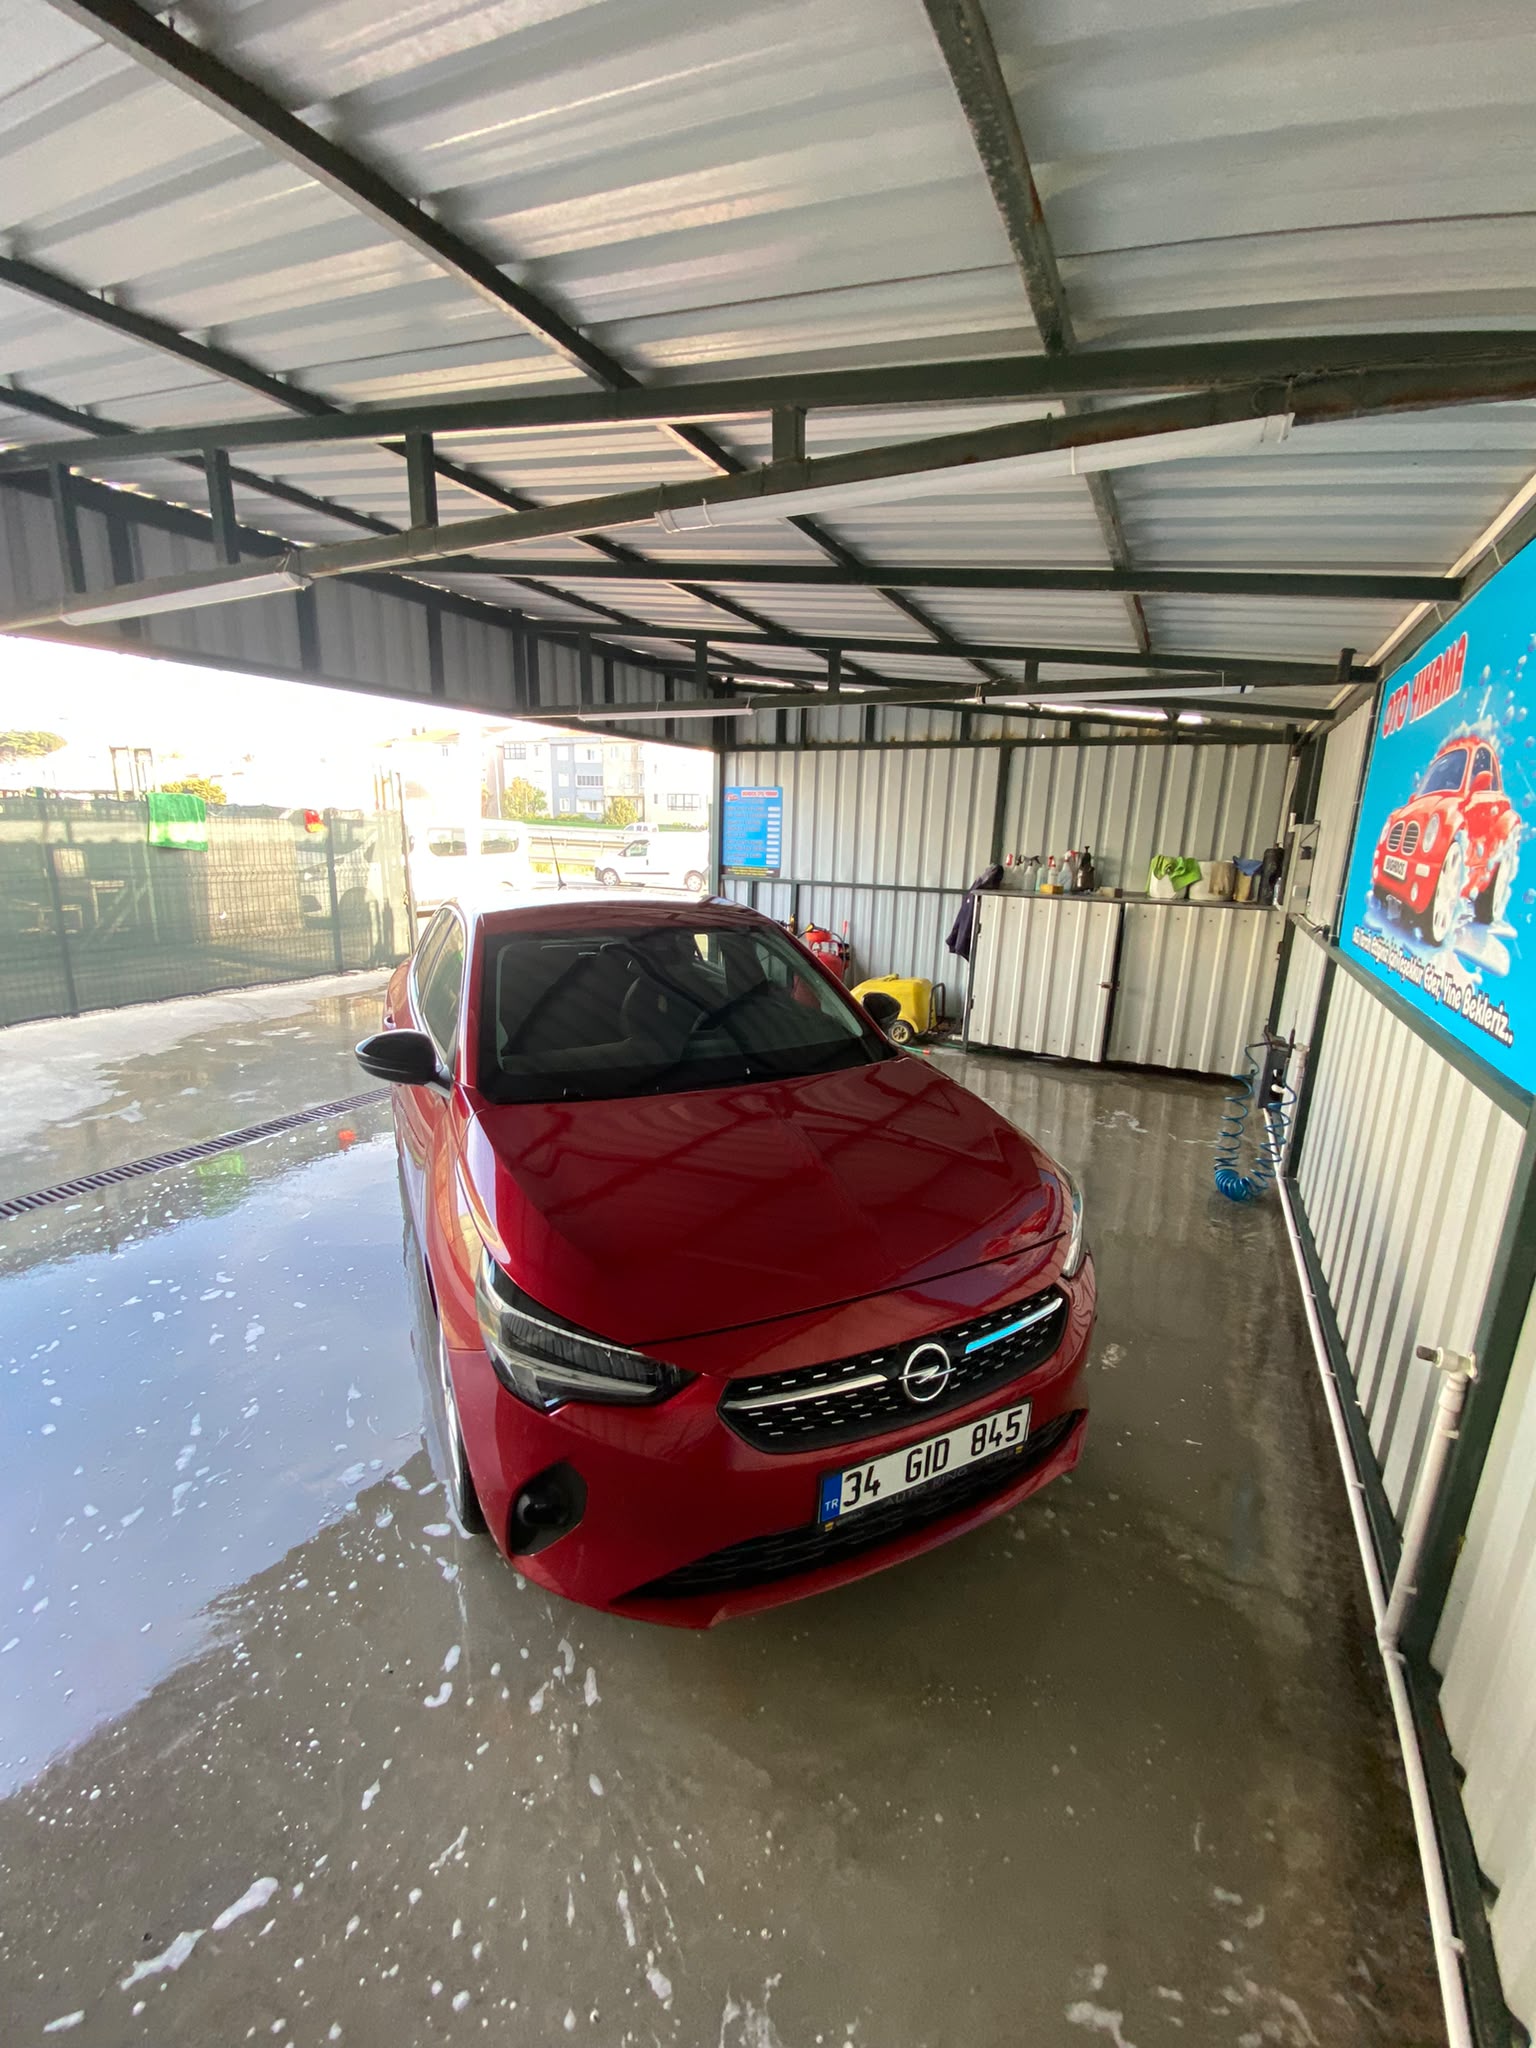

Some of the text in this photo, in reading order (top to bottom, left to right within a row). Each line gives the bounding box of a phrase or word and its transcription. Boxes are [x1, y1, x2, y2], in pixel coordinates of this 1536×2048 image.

[1382, 631, 1468, 739] OTO YIKAMA
[1423, 963, 1441, 1004] Eder,
[1442, 972, 1462, 1013] Yine
[1461, 984, 1514, 1047] Bekleriz..
[843, 1409, 1022, 1507] 34 GID 845
[824, 1498, 838, 1511] TR
